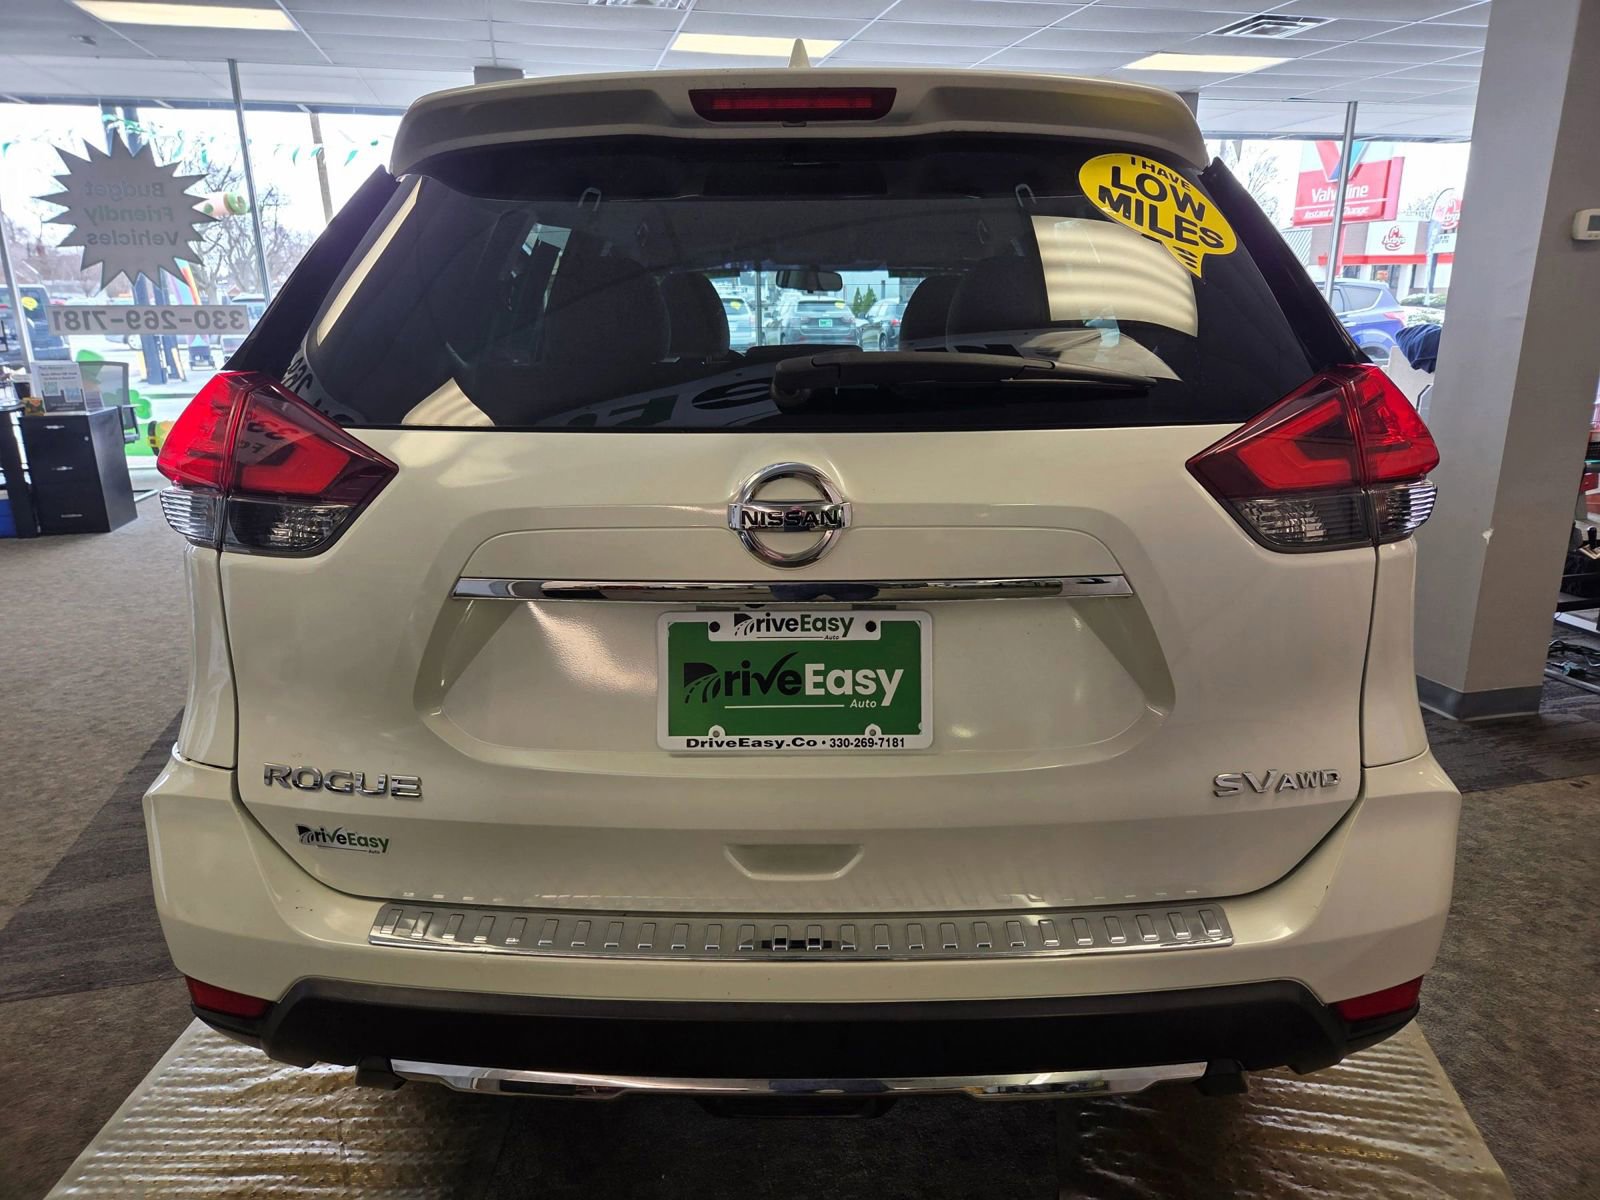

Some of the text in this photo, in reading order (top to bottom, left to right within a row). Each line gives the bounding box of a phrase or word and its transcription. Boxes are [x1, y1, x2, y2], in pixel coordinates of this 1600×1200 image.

[1131, 156, 1192, 192] I HAVE
[1111, 166, 1206, 222] LOW
[1311, 184, 1369, 203] Valvline
[1098, 185, 1225, 249] MILES
[741, 510, 838, 527] NISSAN
[849, 699, 877, 709] Auto
[686, 737, 817, 749] DriveEasy.Co
[263, 762, 422, 798] ROGUE
[1213, 769, 1341, 797] SV AWD
